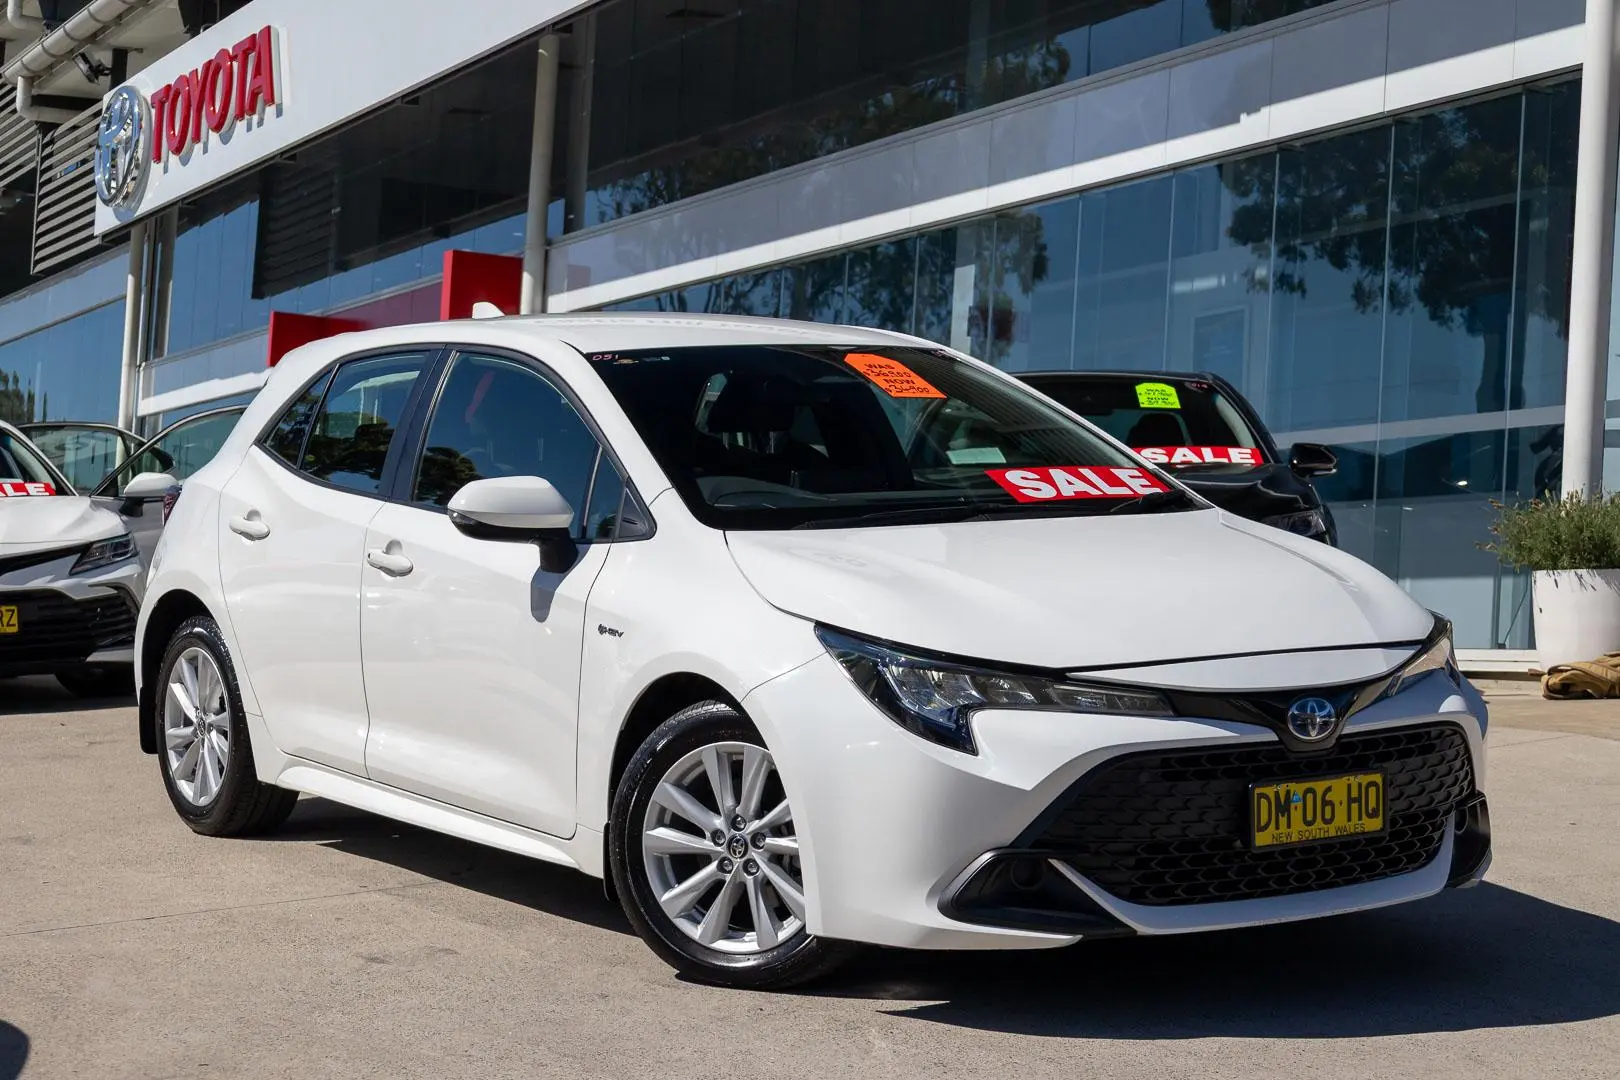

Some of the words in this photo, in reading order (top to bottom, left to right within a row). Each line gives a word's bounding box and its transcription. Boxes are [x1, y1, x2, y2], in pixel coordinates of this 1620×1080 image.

[151, 25, 276, 164] TOYOTA
[1140, 447, 1255, 464] SALE
[0, 483, 50, 496] LE
[1004, 468, 1163, 499] SALE
[1272, 831, 1293, 844] NEW
[1298, 827, 1329, 840] SOUTH
[1335, 823, 1366, 836] WALES
